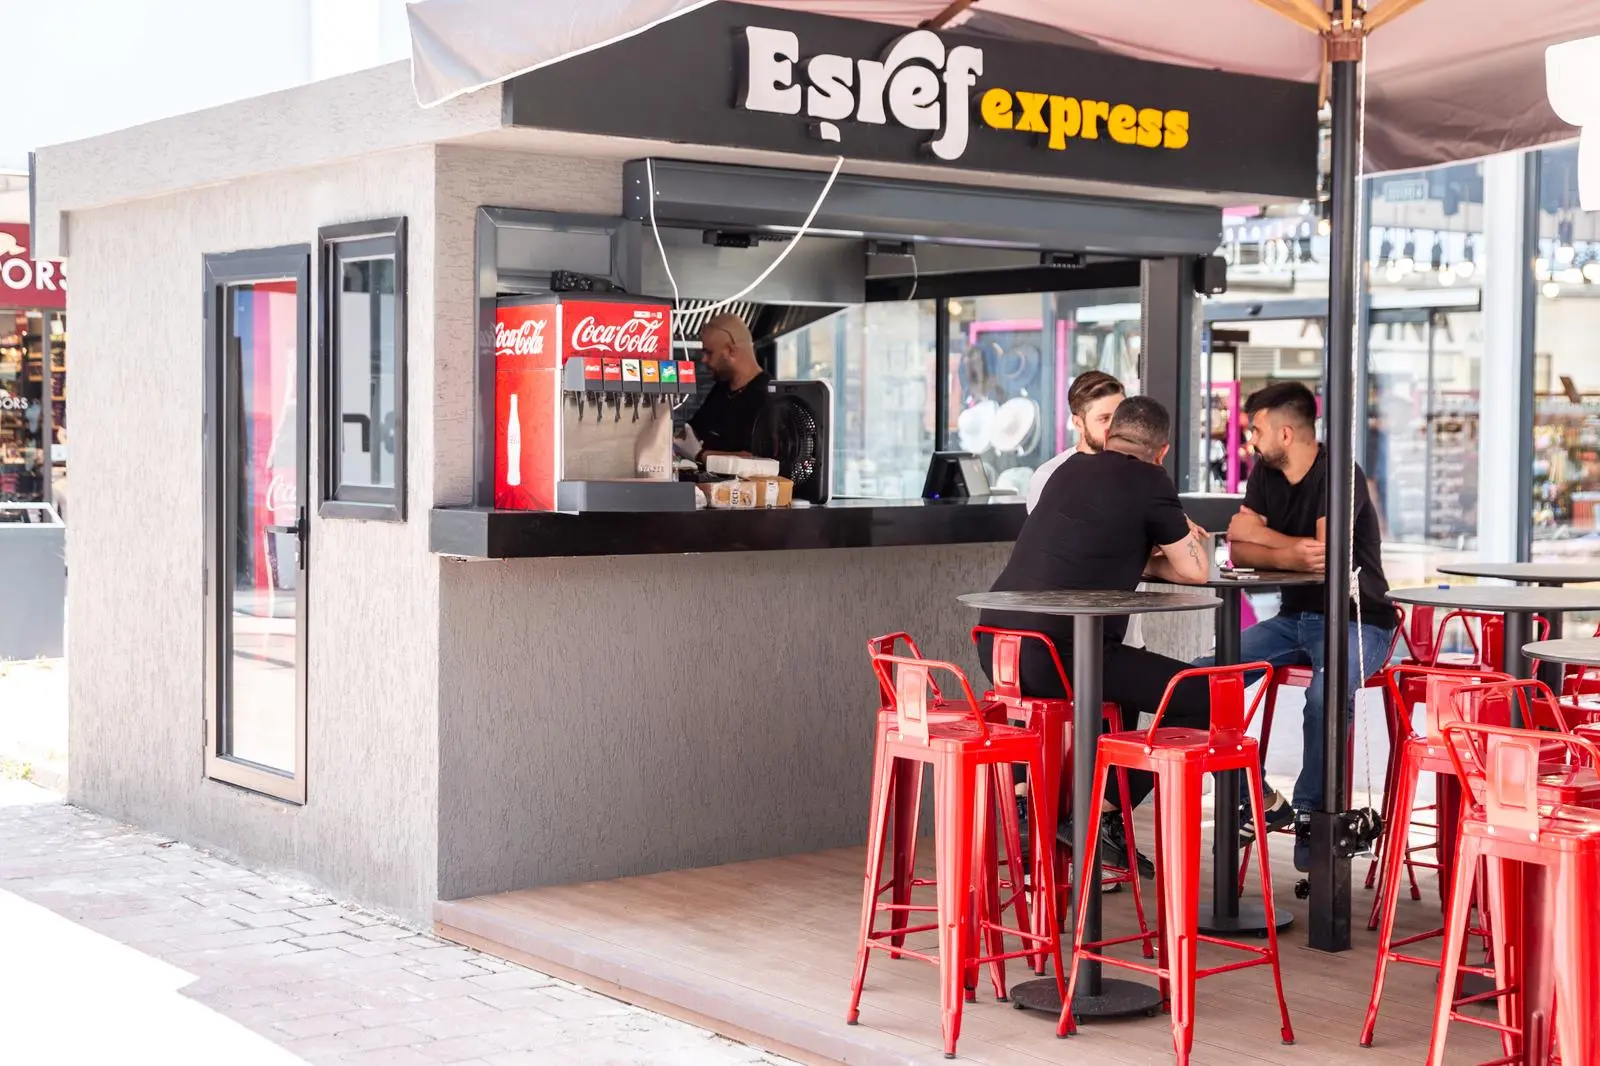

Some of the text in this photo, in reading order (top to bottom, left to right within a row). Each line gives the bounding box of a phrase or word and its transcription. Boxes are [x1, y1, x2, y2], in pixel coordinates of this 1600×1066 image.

[744, 26, 1190, 160] Eşref express
[571, 315, 664, 353] Coca-Cola
[0, 396, 29, 410] ORS
